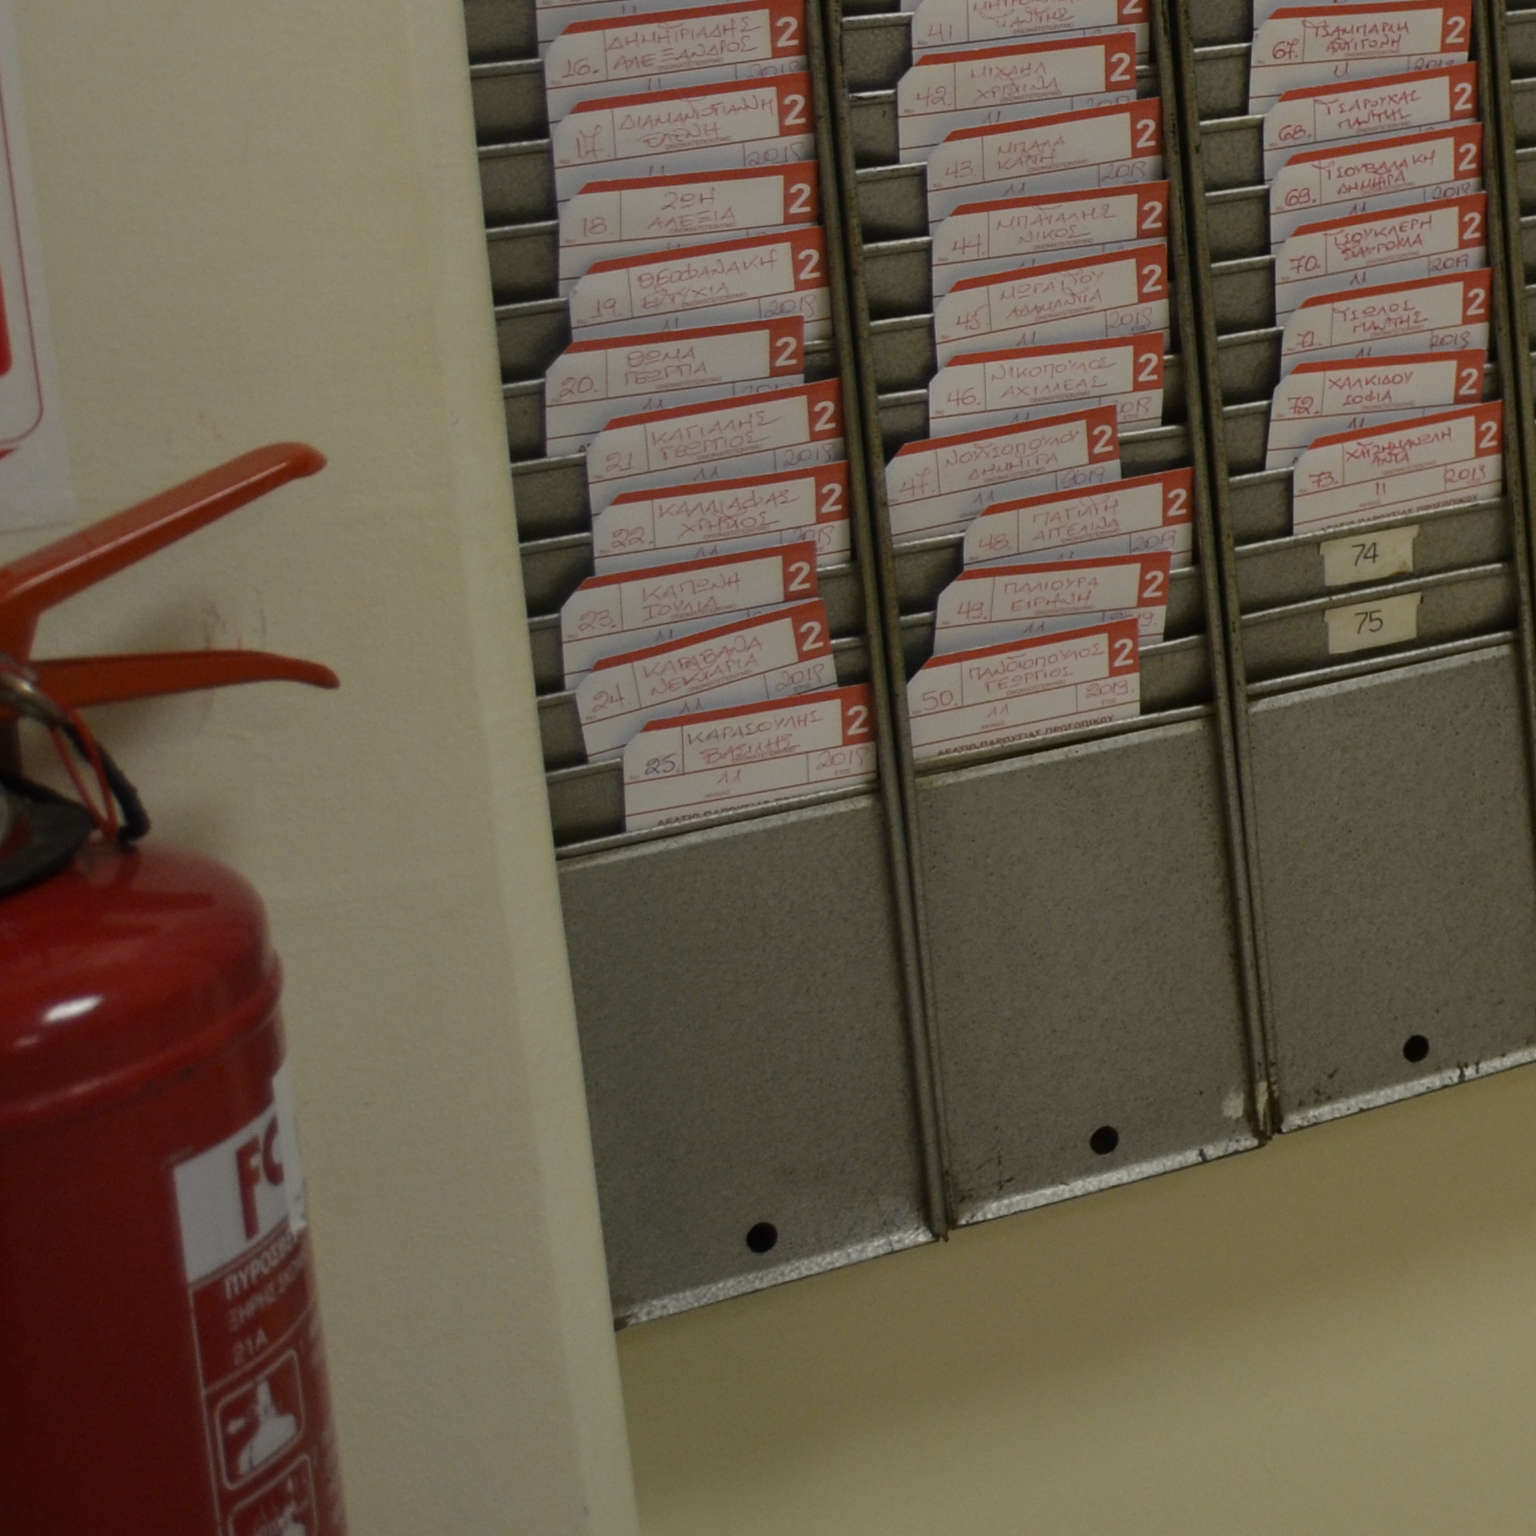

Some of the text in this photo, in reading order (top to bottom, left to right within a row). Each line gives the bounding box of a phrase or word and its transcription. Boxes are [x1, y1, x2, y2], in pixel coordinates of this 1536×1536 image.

[784, 95, 807, 125] 2
[1137, 119, 1157, 148] 2
[1464, 213, 1481, 240] 2
[774, 337, 798, 367] 2
[1139, 353, 1158, 381] 2
[1480, 421, 1497, 448] 2
[1351, 541, 1379, 567] 74
[1354, 608, 1384, 635] 75
[800, 621, 823, 651] 2
[1114, 639, 1133, 667] 2
